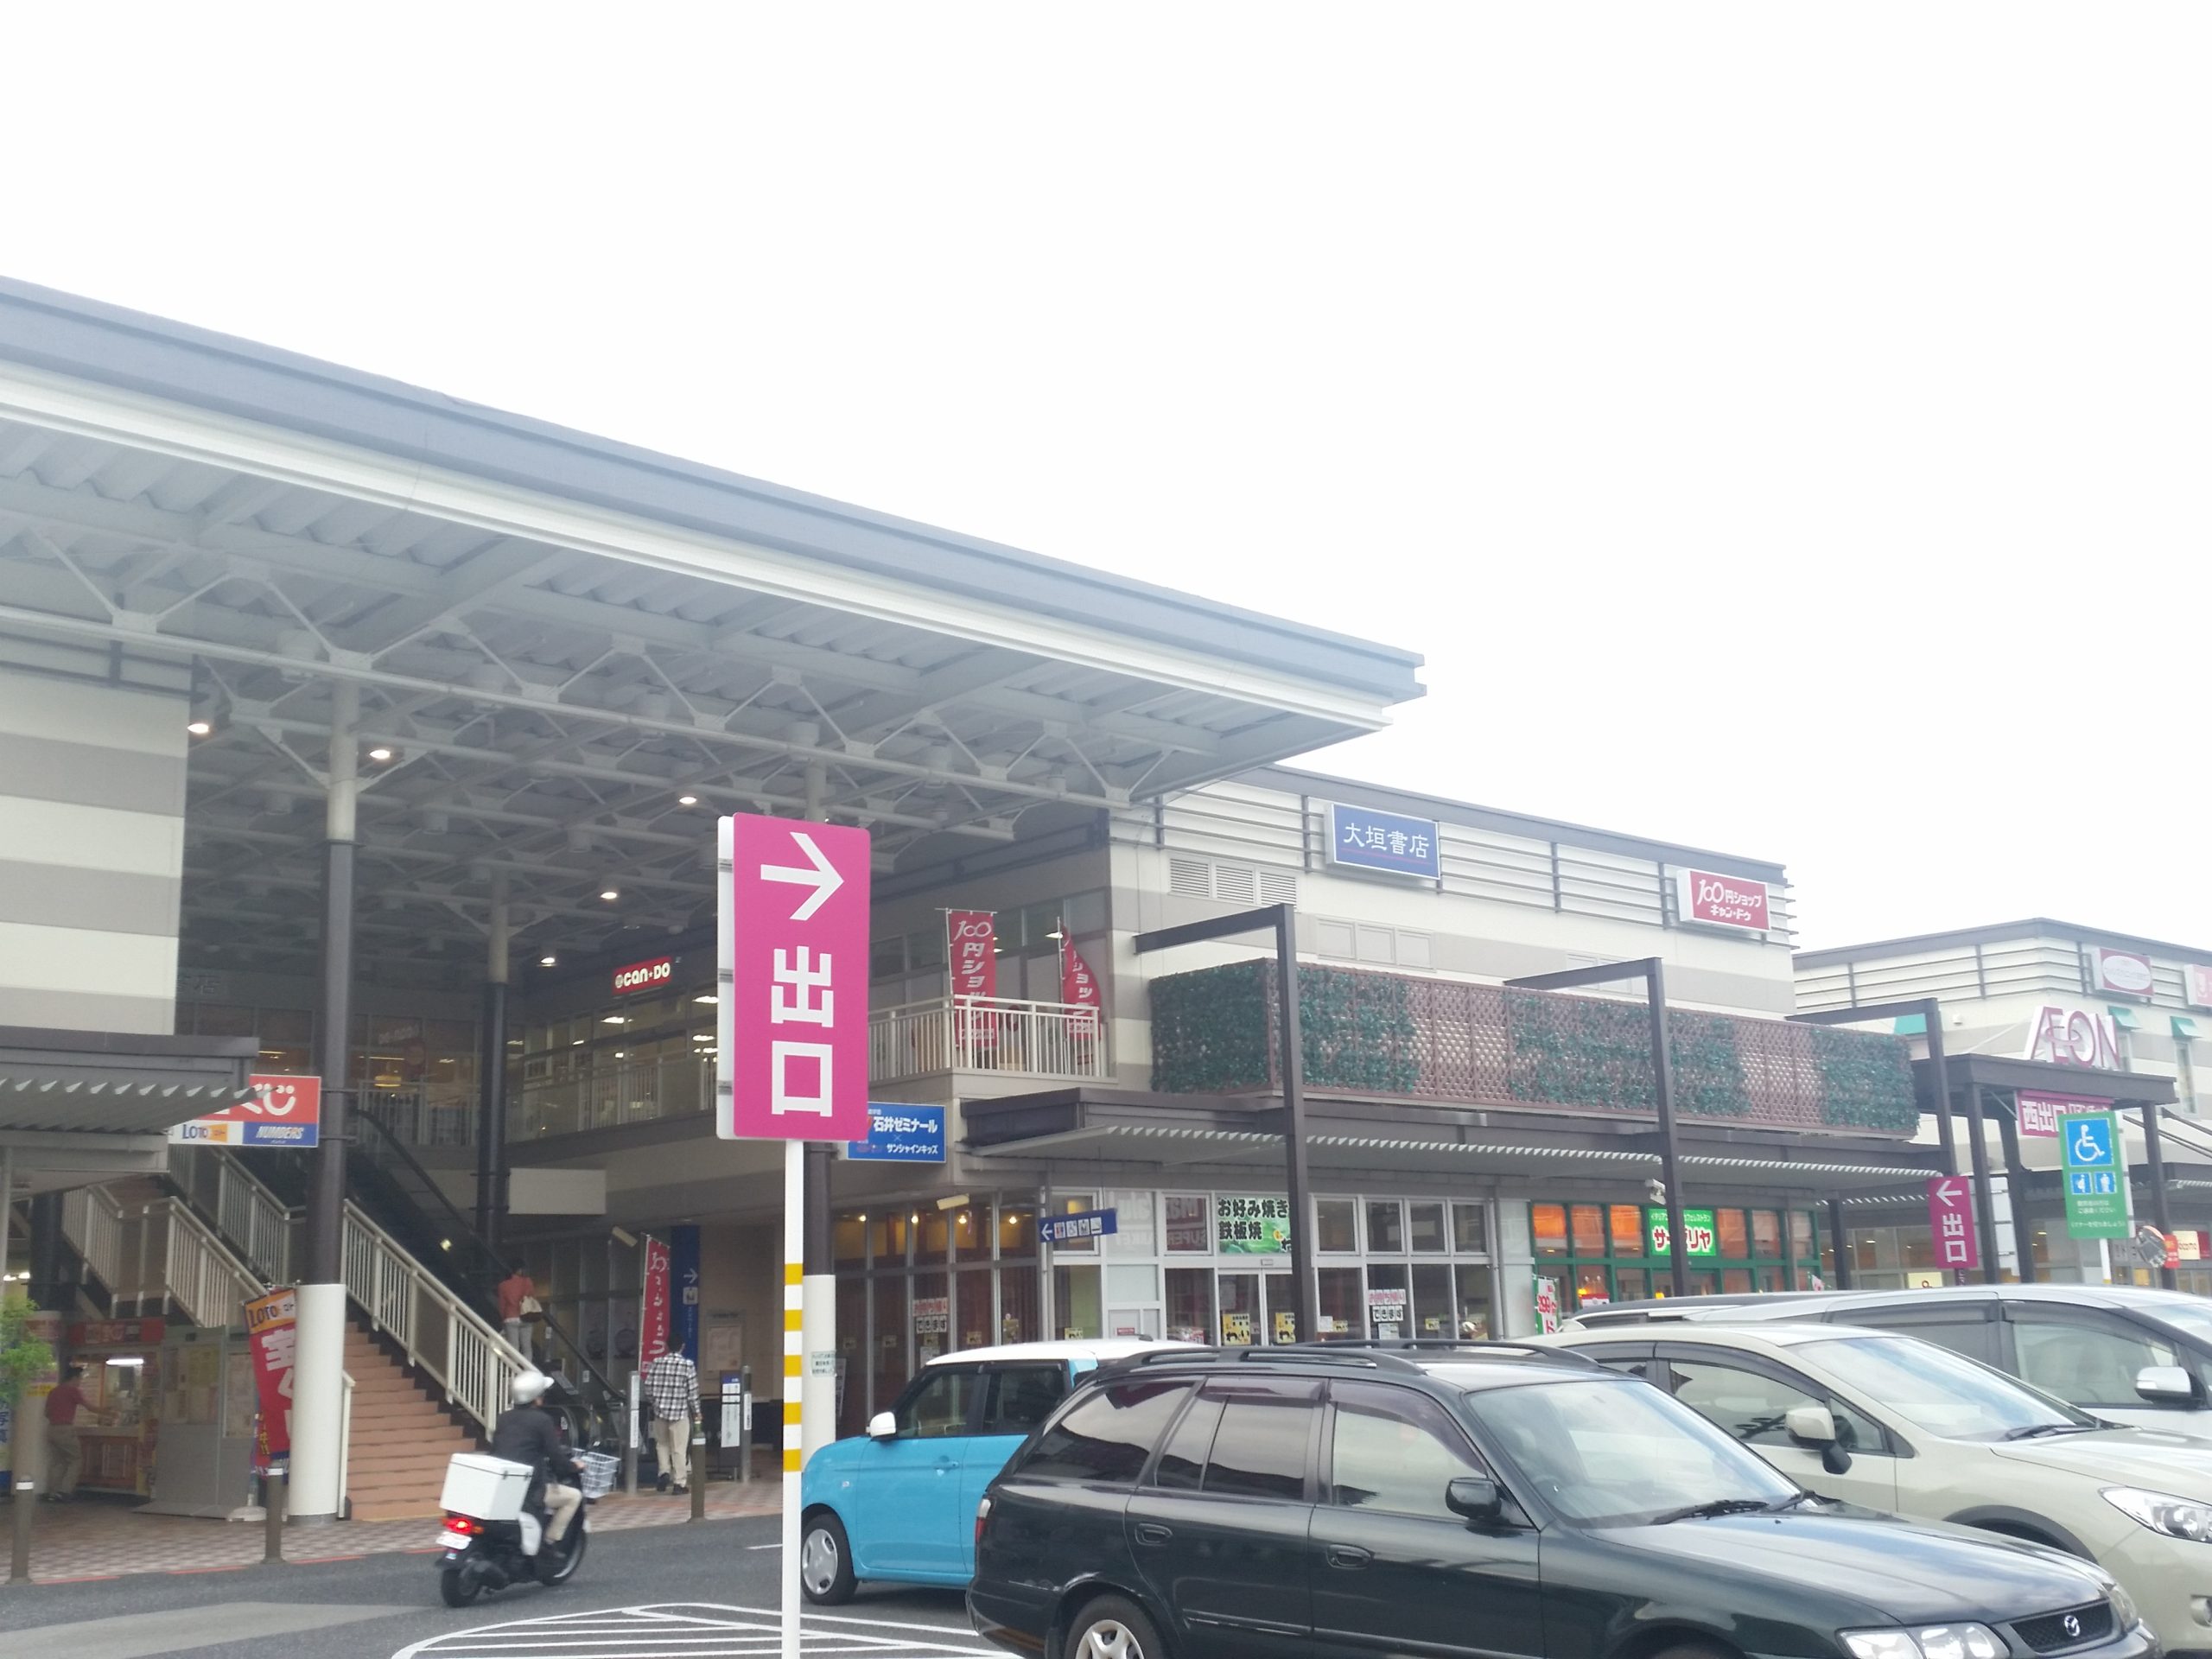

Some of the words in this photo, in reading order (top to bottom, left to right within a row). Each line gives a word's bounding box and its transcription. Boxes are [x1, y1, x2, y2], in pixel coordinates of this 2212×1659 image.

[1344, 823, 1429, 858] 大垣書店
[1697, 880, 1762, 907] 100円ショップ
[771, 945, 834, 1117] 出口
[873, 1116, 938, 1134] 石井ゼミナール
[887, 1143, 938, 1154] サンシャインキッズ
[1218, 1198, 1288, 1218] お好み焼き
[1218, 1221, 1262, 1241] 鉄板焼
[1653, 1227, 1712, 1250] サリヤ
[1942, 1213, 1967, 1262] 出口
